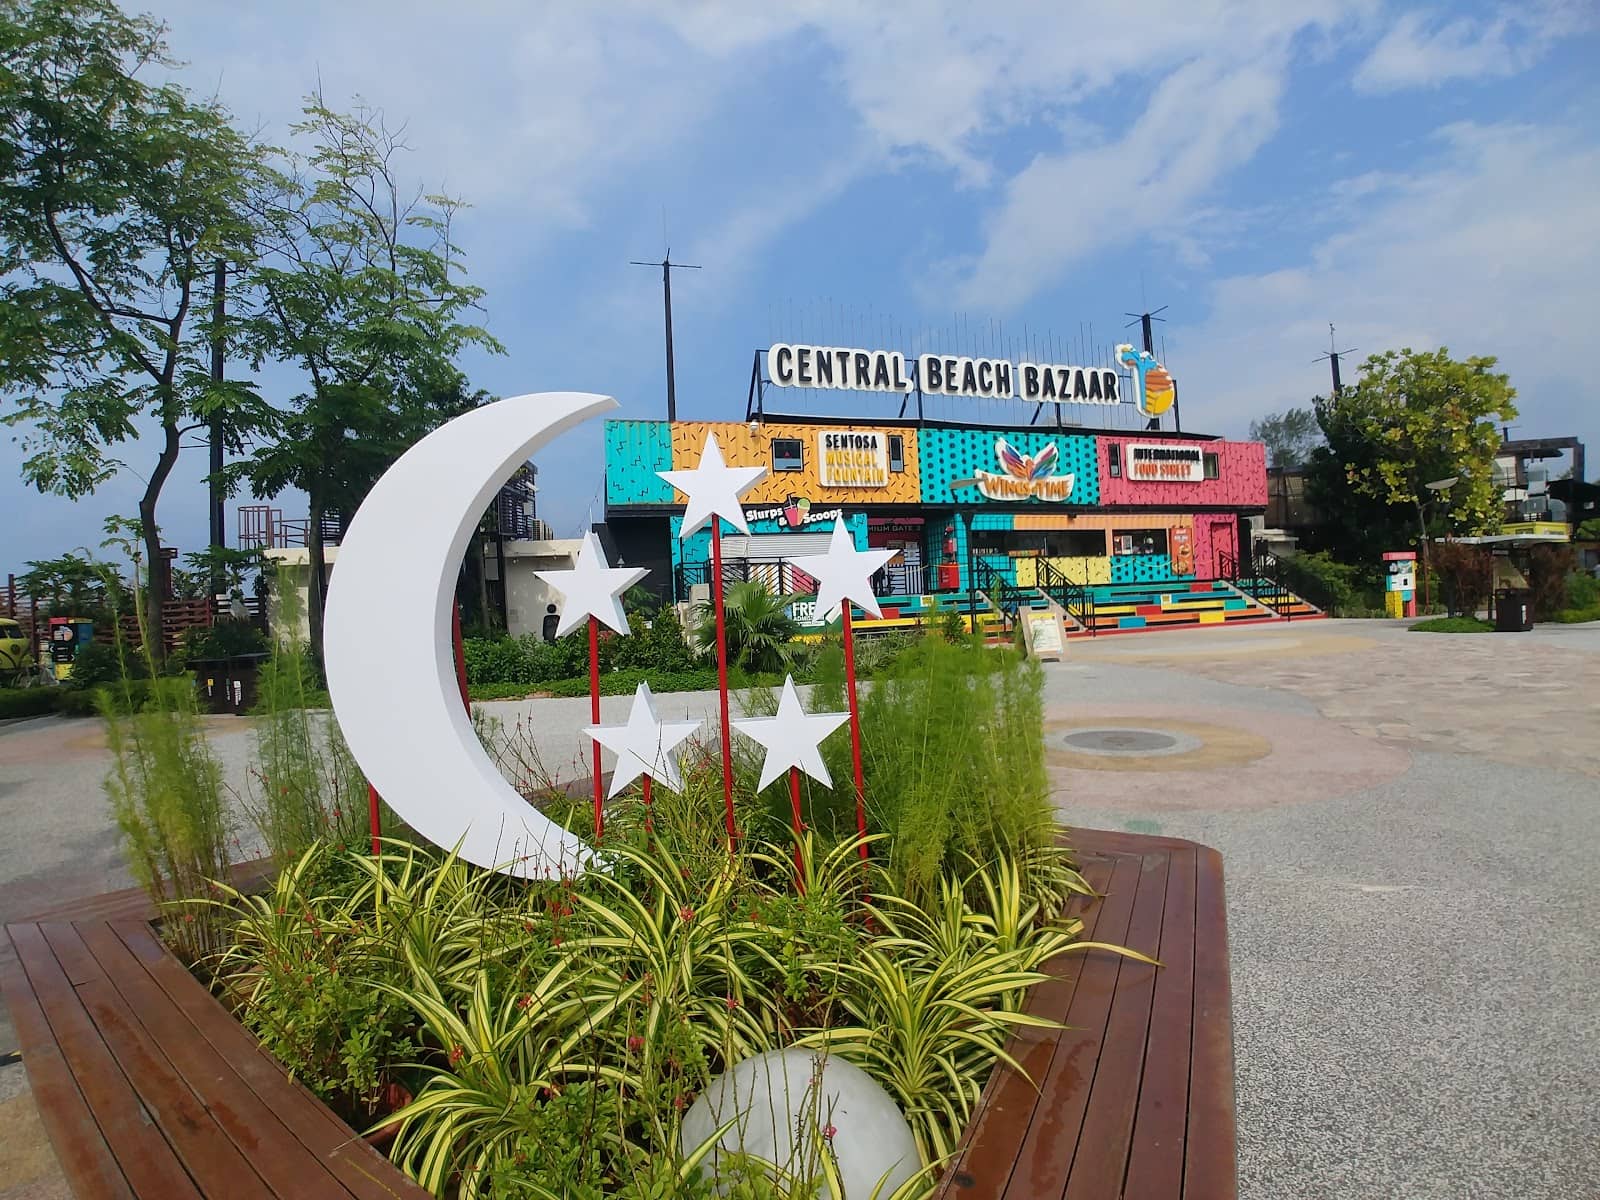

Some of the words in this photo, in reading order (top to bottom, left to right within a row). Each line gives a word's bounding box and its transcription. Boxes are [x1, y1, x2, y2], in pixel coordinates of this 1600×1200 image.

[776, 347, 908, 390] CENTRAL
[927, 356, 1012, 395] BEACH
[1024, 365, 1119, 402] BAZAAR
[826, 434, 878, 449] SENTOSA
[826, 451, 877, 466] MUSICAL
[827, 467, 884, 482] FOUNTAIN
[1134, 463, 1158, 475] FOOD
[982, 474, 1031, 496] WINGS
[1036, 479, 1070, 497] TIME
[745, 507, 784, 522] Slurps
[779, 516, 788, 526] &
[803, 508, 843, 524] Scoops
[792, 601, 816, 616] FRE
